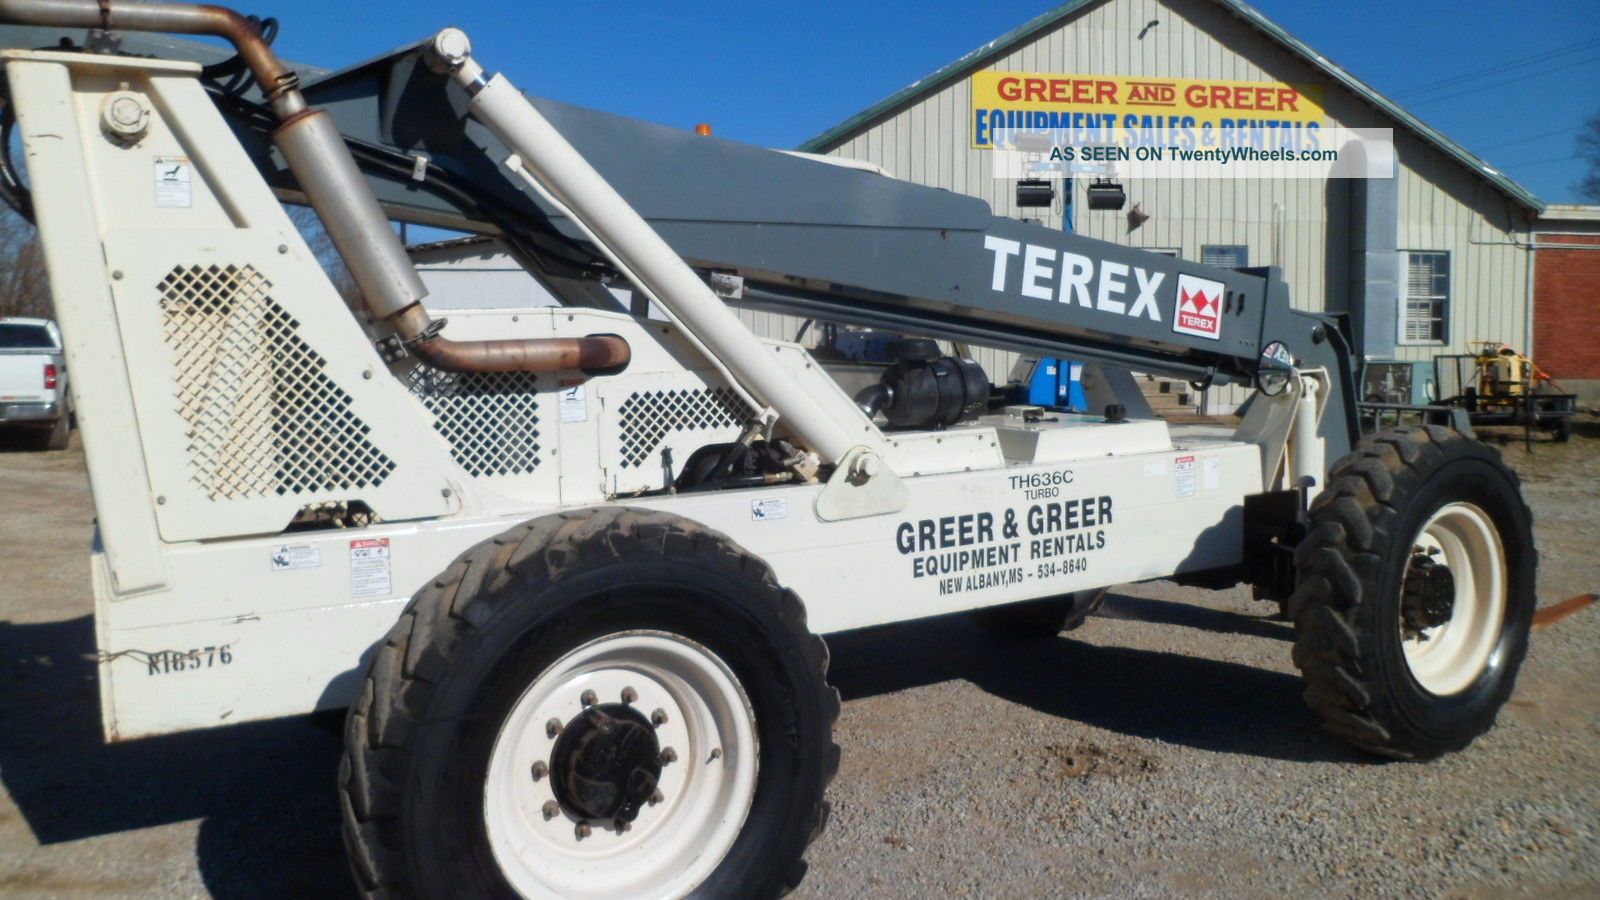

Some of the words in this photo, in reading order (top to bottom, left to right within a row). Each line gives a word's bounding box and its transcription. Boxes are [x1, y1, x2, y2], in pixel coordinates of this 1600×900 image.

[997, 77, 1119, 104] GREER
[1127, 84, 1176, 102] AND
[1184, 85, 1300, 112] GREER
[975, 109, 1118, 148] EQUIPMENT
[1122, 113, 1196, 149] SALES
[1200, 121, 1216, 147] &
[1220, 118, 1321, 152] RENTALS
[984, 235, 1166, 322] TEREX
[1181, 314, 1214, 330] TEREX
[1009, 470, 1074, 490] TH636C
[1024, 486, 1060, 500] TURBO
[896, 511, 994, 555] GREER
[1002, 508, 1019, 540] &
[1027, 495, 1113, 536] GREER
[913, 543, 1021, 579] EQUIPMENT
[1030, 530, 1106, 560] RENTALS
[939, 576, 963, 596] NEW
[1037, 557, 1087, 580] 534-8640
